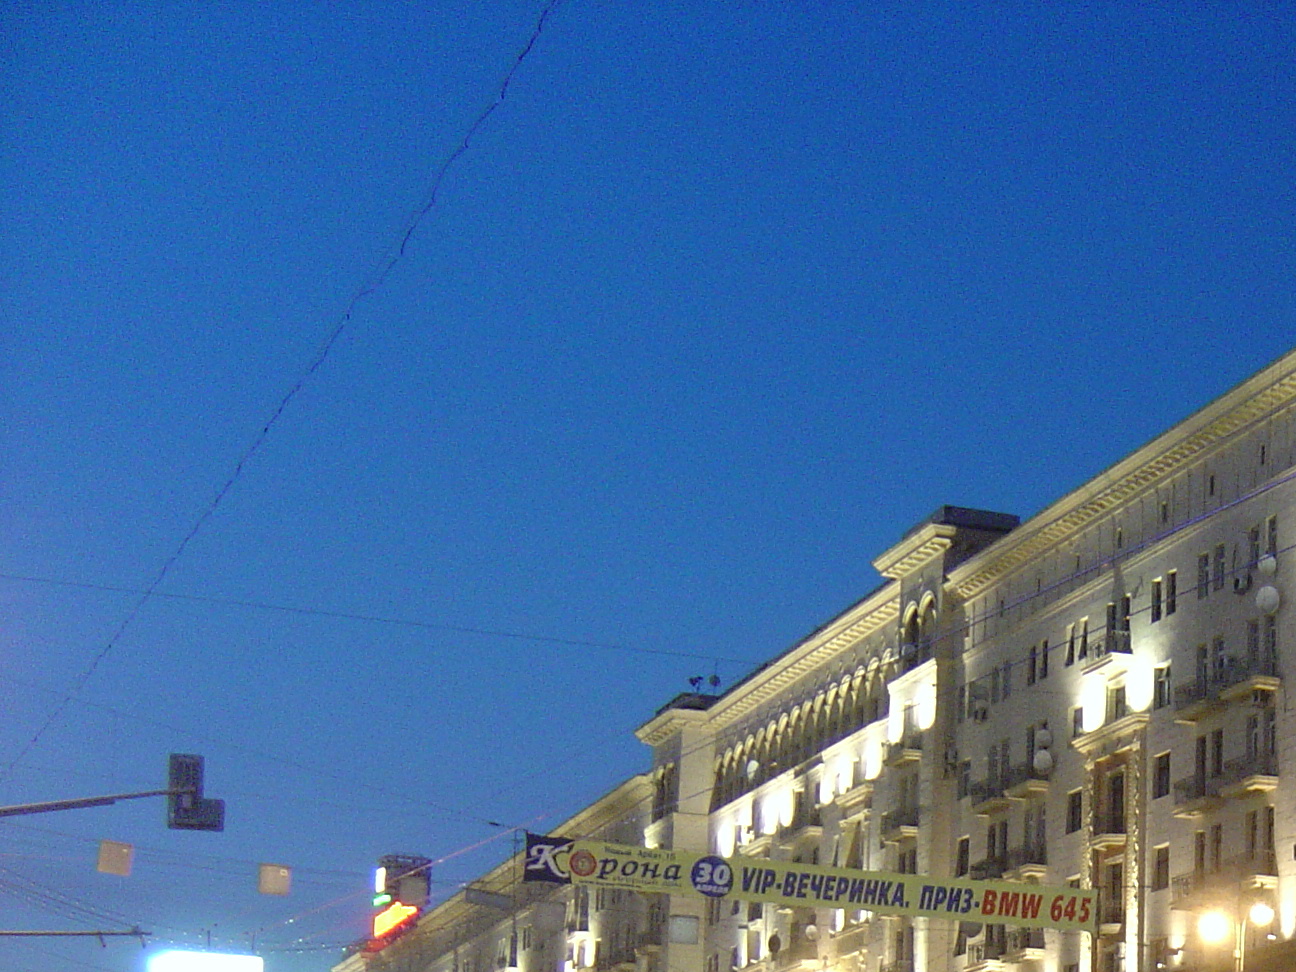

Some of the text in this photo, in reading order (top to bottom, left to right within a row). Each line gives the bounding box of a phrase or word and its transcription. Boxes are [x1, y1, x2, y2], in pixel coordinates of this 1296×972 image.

[695, 864, 731, 883] 30
[742, 866, 910, 909] VIP-ВЕЧЕРИНКА.
[1050, 897, 1092, 923] 645
